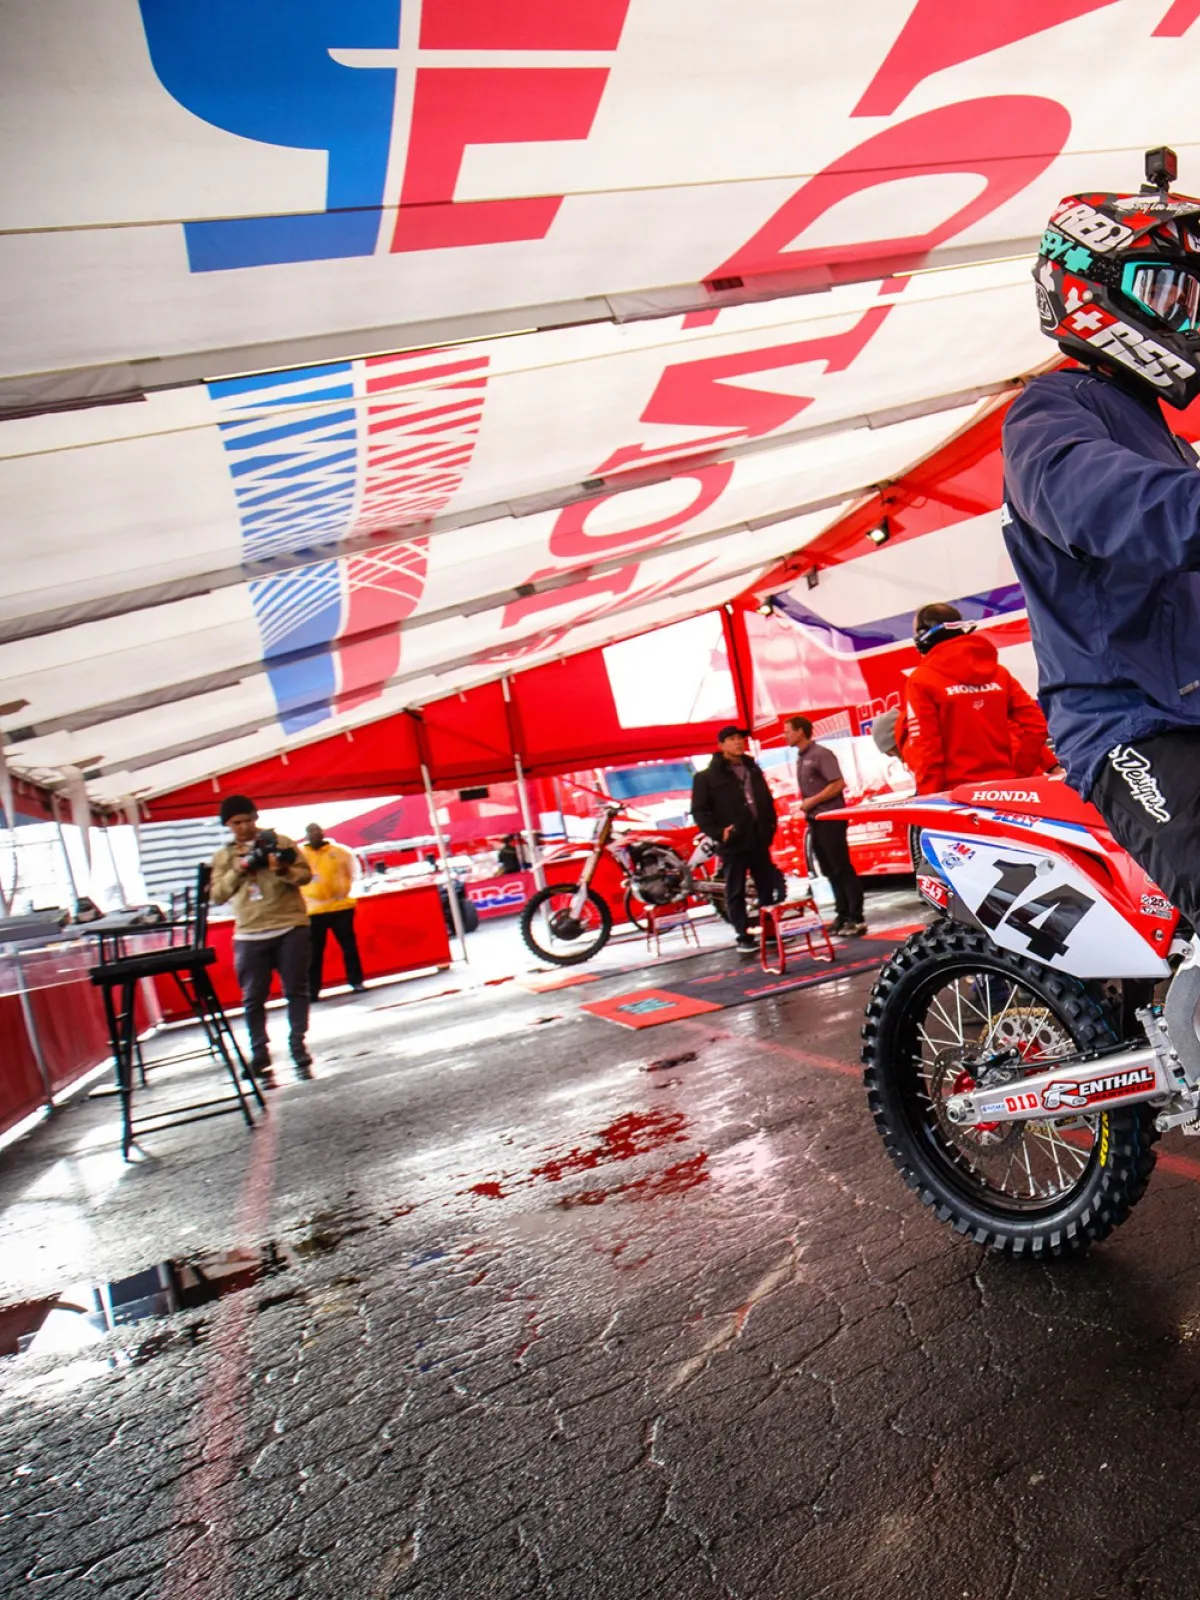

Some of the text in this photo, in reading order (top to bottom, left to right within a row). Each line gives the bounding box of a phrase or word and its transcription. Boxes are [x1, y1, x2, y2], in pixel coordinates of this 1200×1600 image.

[944, 682, 1002, 697] HONDA
[972, 790, 1041, 803] HONDA
[975, 859, 1096, 962] 14
[1005, 1093, 1039, 1112] DID
[1043, 1069, 1153, 1108] RENTHAL
[1100, 1111, 1110, 1168] NLOP
